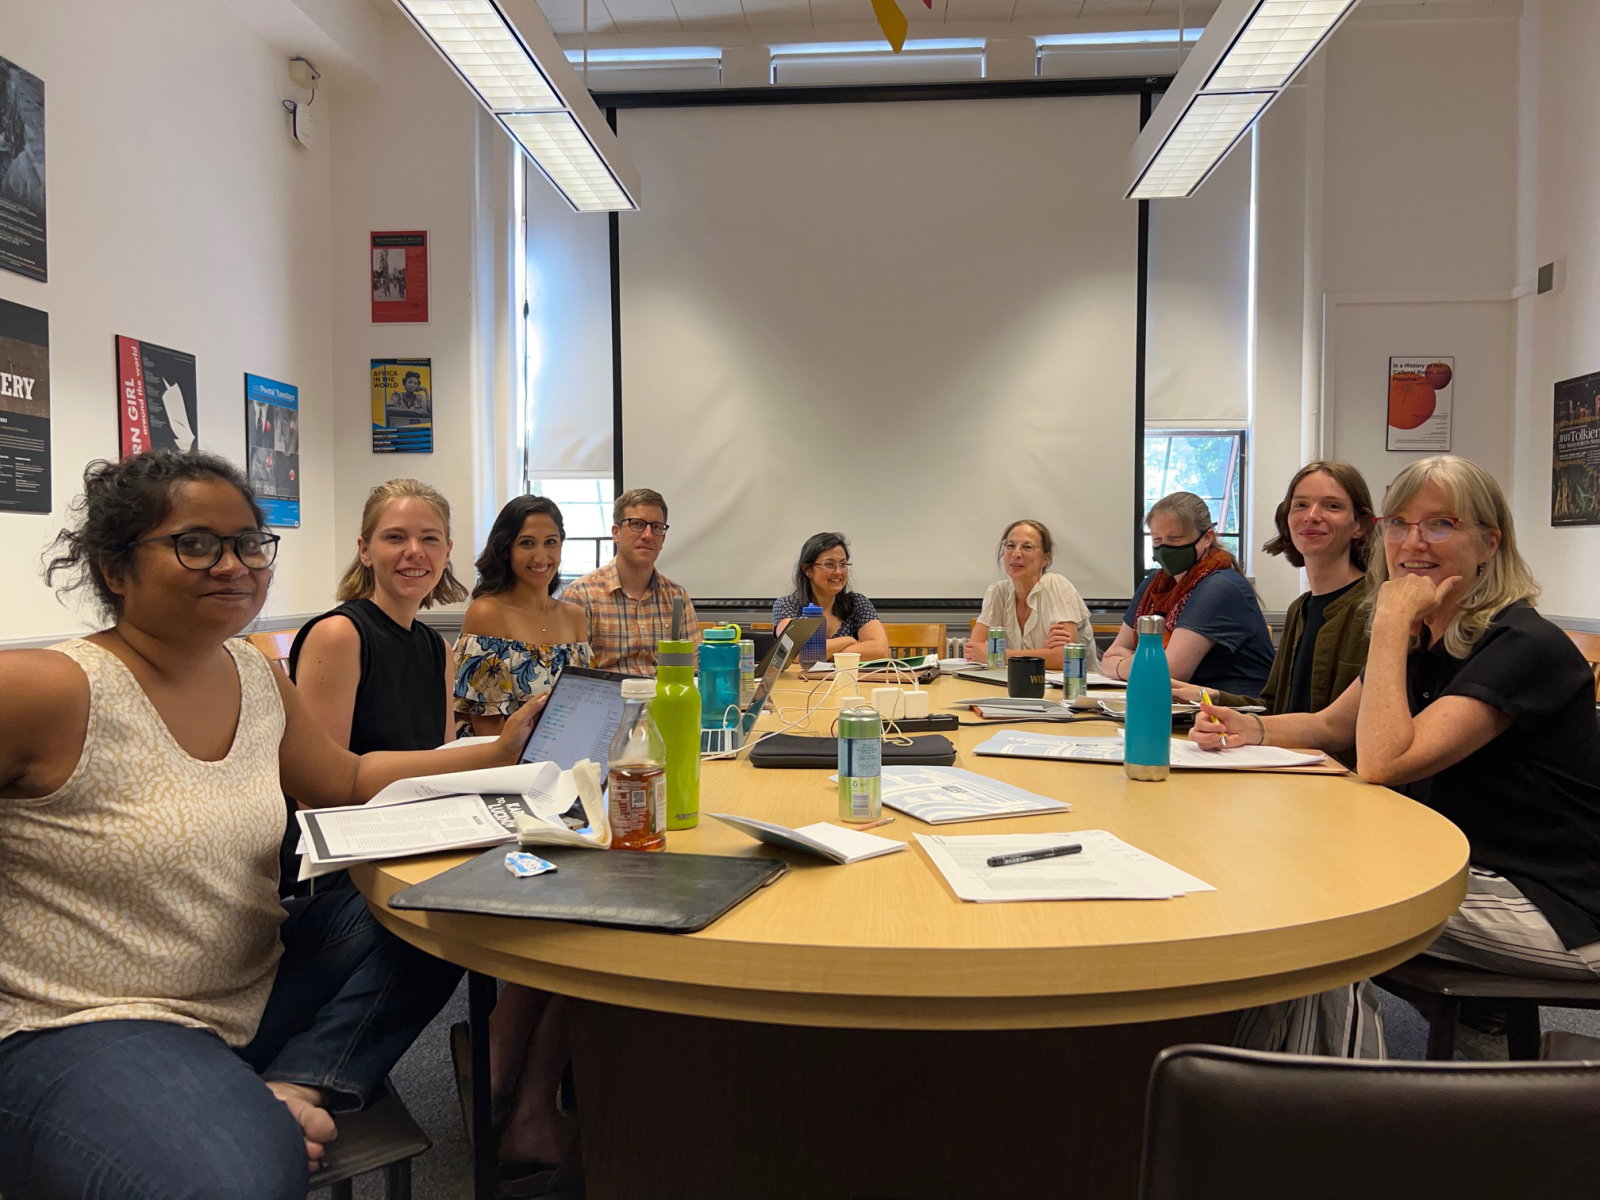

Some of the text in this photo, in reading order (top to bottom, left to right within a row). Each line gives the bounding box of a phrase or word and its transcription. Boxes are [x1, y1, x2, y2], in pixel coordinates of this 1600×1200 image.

[125, 377, 138, 421] GIRL
[131, 346, 148, 435] around the world
[260, 384, 275, 396] Pivotal
